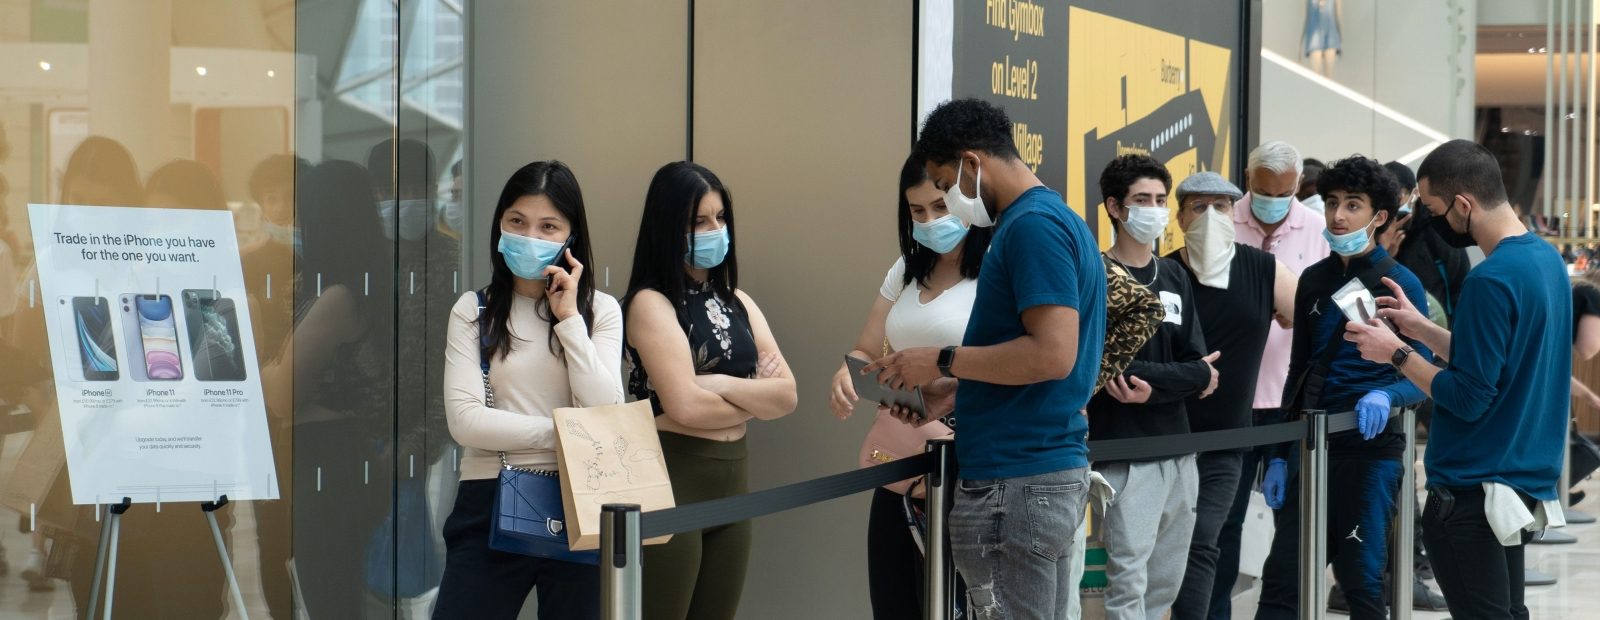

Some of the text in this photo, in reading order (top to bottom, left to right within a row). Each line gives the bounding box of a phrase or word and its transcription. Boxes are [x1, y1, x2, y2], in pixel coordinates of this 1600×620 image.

[986, 0, 1045, 42] Find Gymbox
[991, 54, 1038, 100] on Level 2
[1012, 122, 1043, 174] Village
[53, 232, 216, 249] Trade in the iPhone you have
[81, 248, 200, 264] for the one you want.
[81, 389, 105, 397] iPhone
[146, 388, 175, 396] iPhone 11
[203, 388, 244, 396] iPhone 11 Pro
